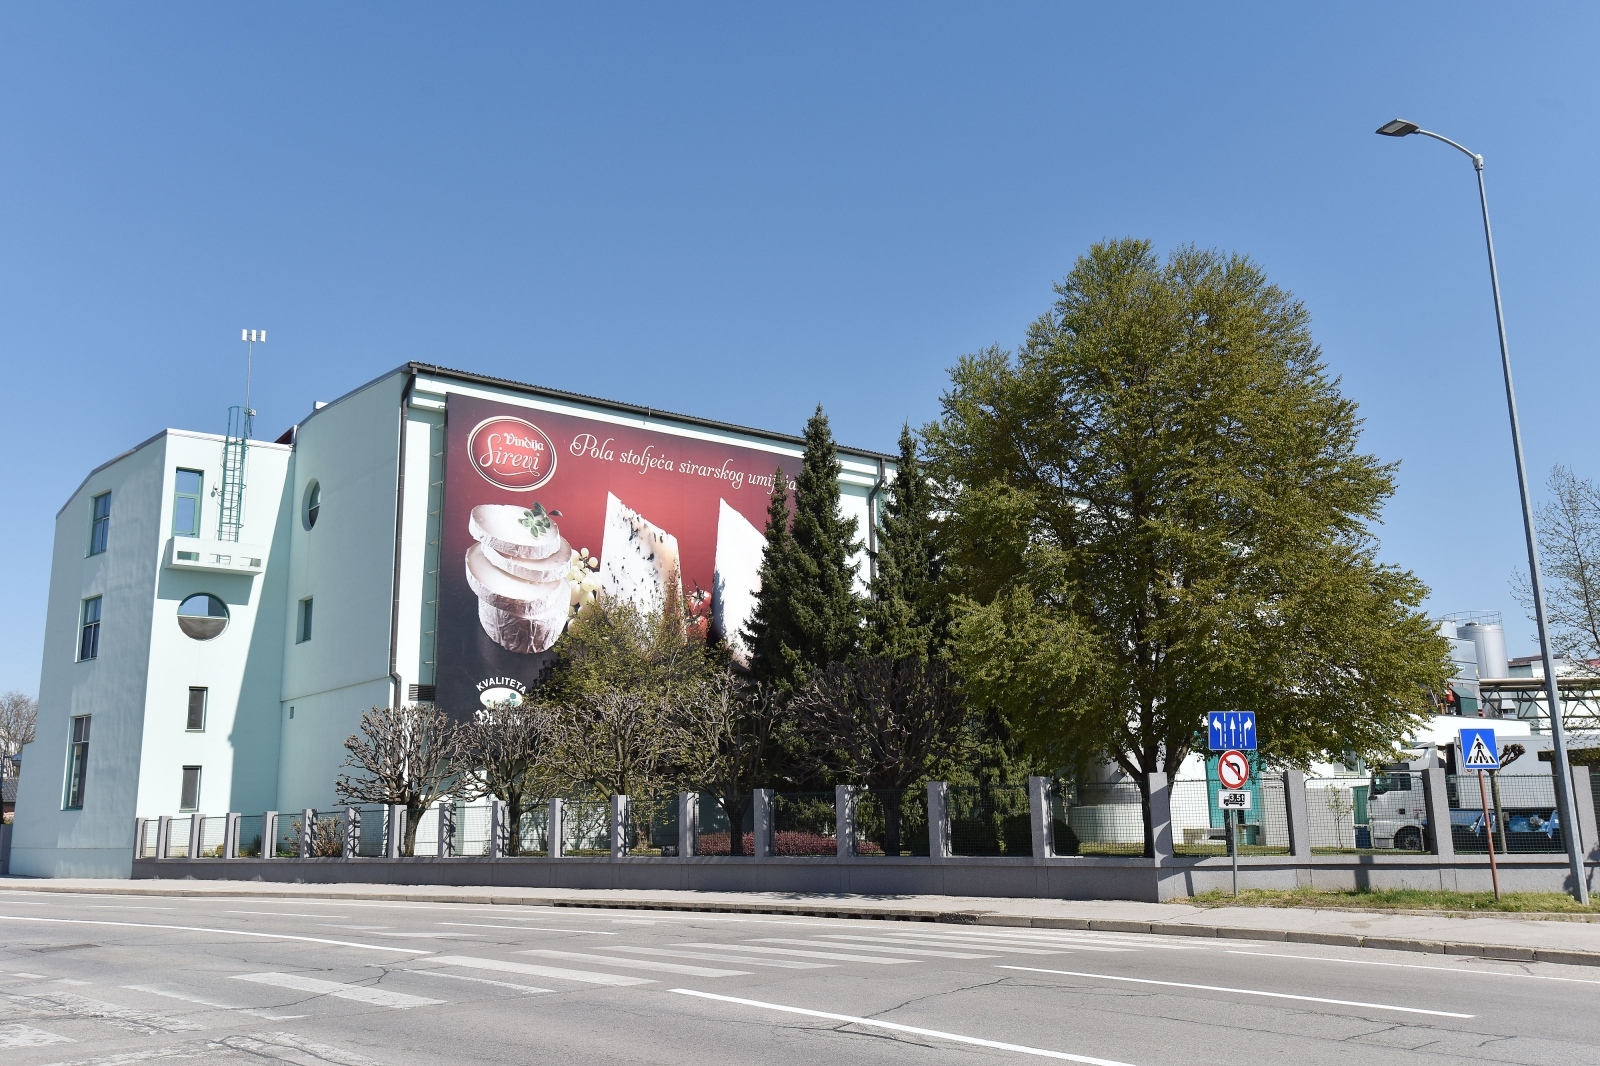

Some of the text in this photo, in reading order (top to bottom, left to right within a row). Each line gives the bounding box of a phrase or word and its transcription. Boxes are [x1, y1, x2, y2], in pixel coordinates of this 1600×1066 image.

[480, 433, 541, 477] Sirevi
[503, 432, 545, 452] Vindija
[569, 433, 615, 461] Pola
[619, 445, 674, 475] stoljeća
[678, 458, 745, 489] sirarskog
[475, 676, 527, 695] KVALITETA
